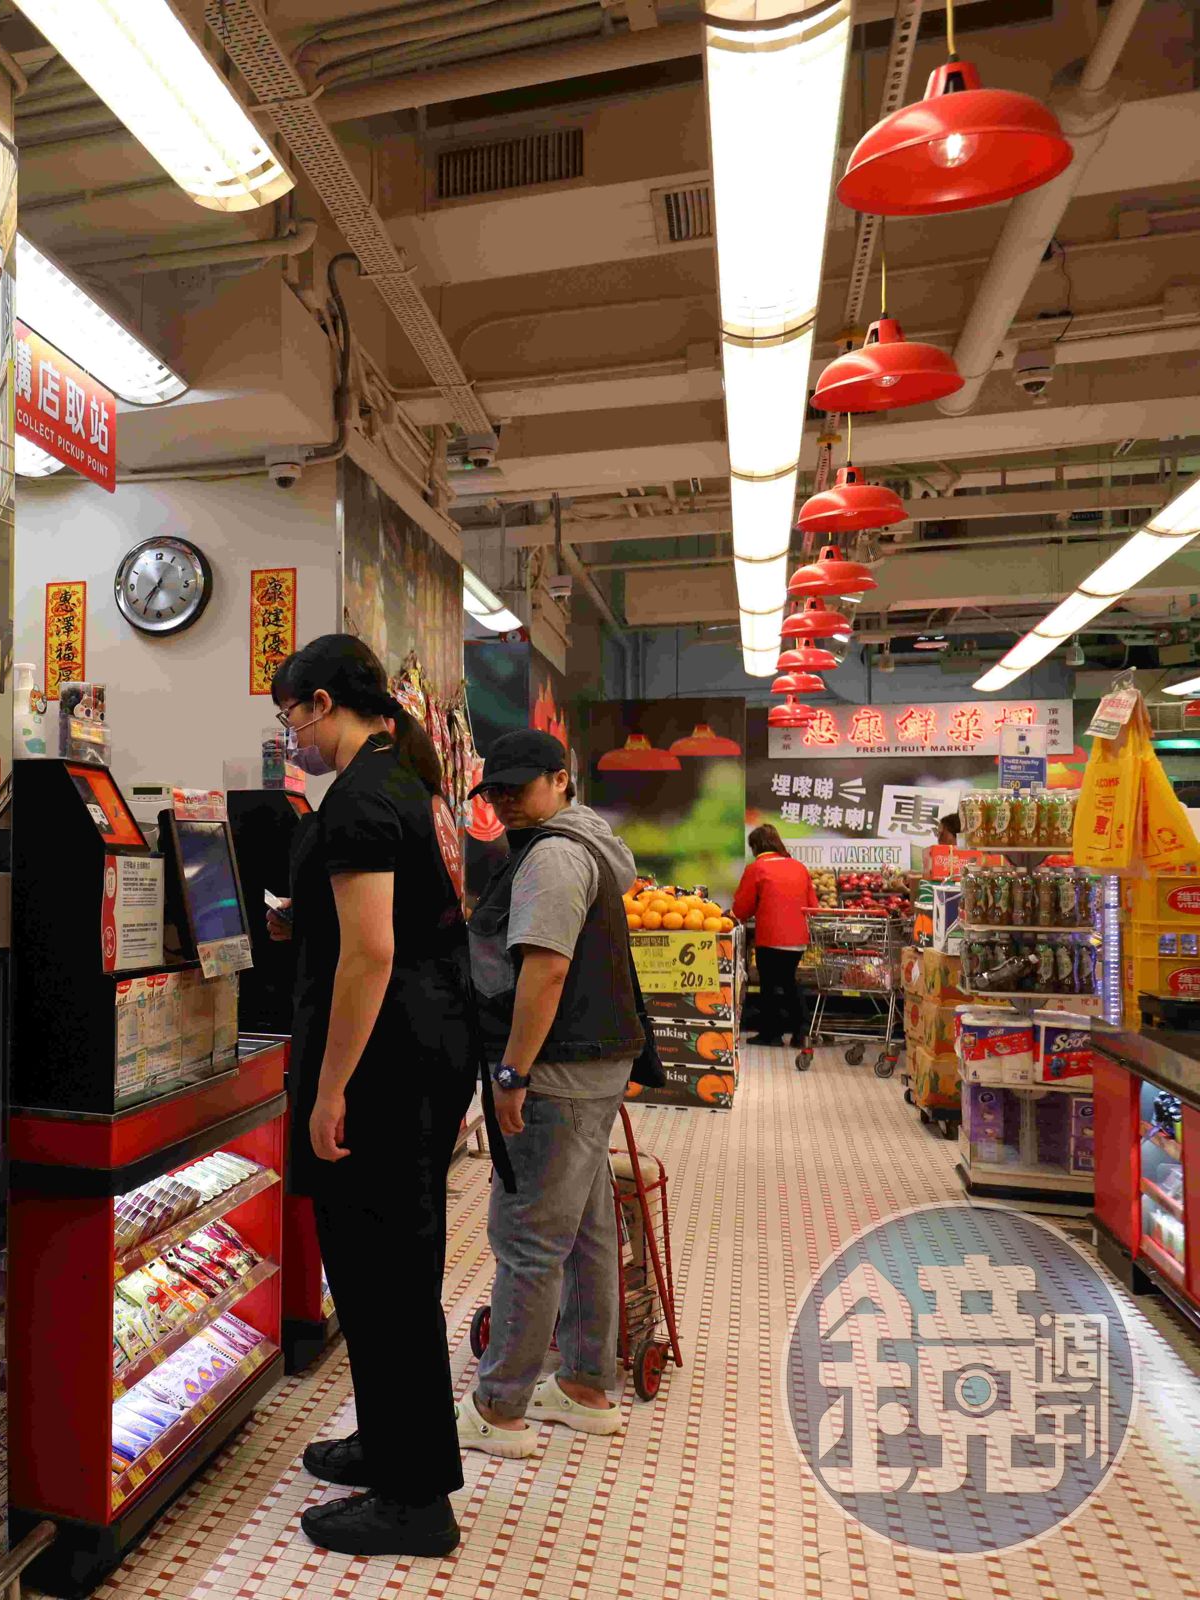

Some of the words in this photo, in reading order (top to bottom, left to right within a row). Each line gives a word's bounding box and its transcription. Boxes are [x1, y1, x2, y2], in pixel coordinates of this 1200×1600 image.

[17, 409, 54, 442] COLLECT
[57, 433, 85, 463] PICKUP
[87, 452, 109, 478] POINT
[856, 745, 890, 754] FRESH
[893, 745, 921, 753] FRUIT
[924, 744, 977, 753] MARKET
[830, 845, 902, 864] MARKET
